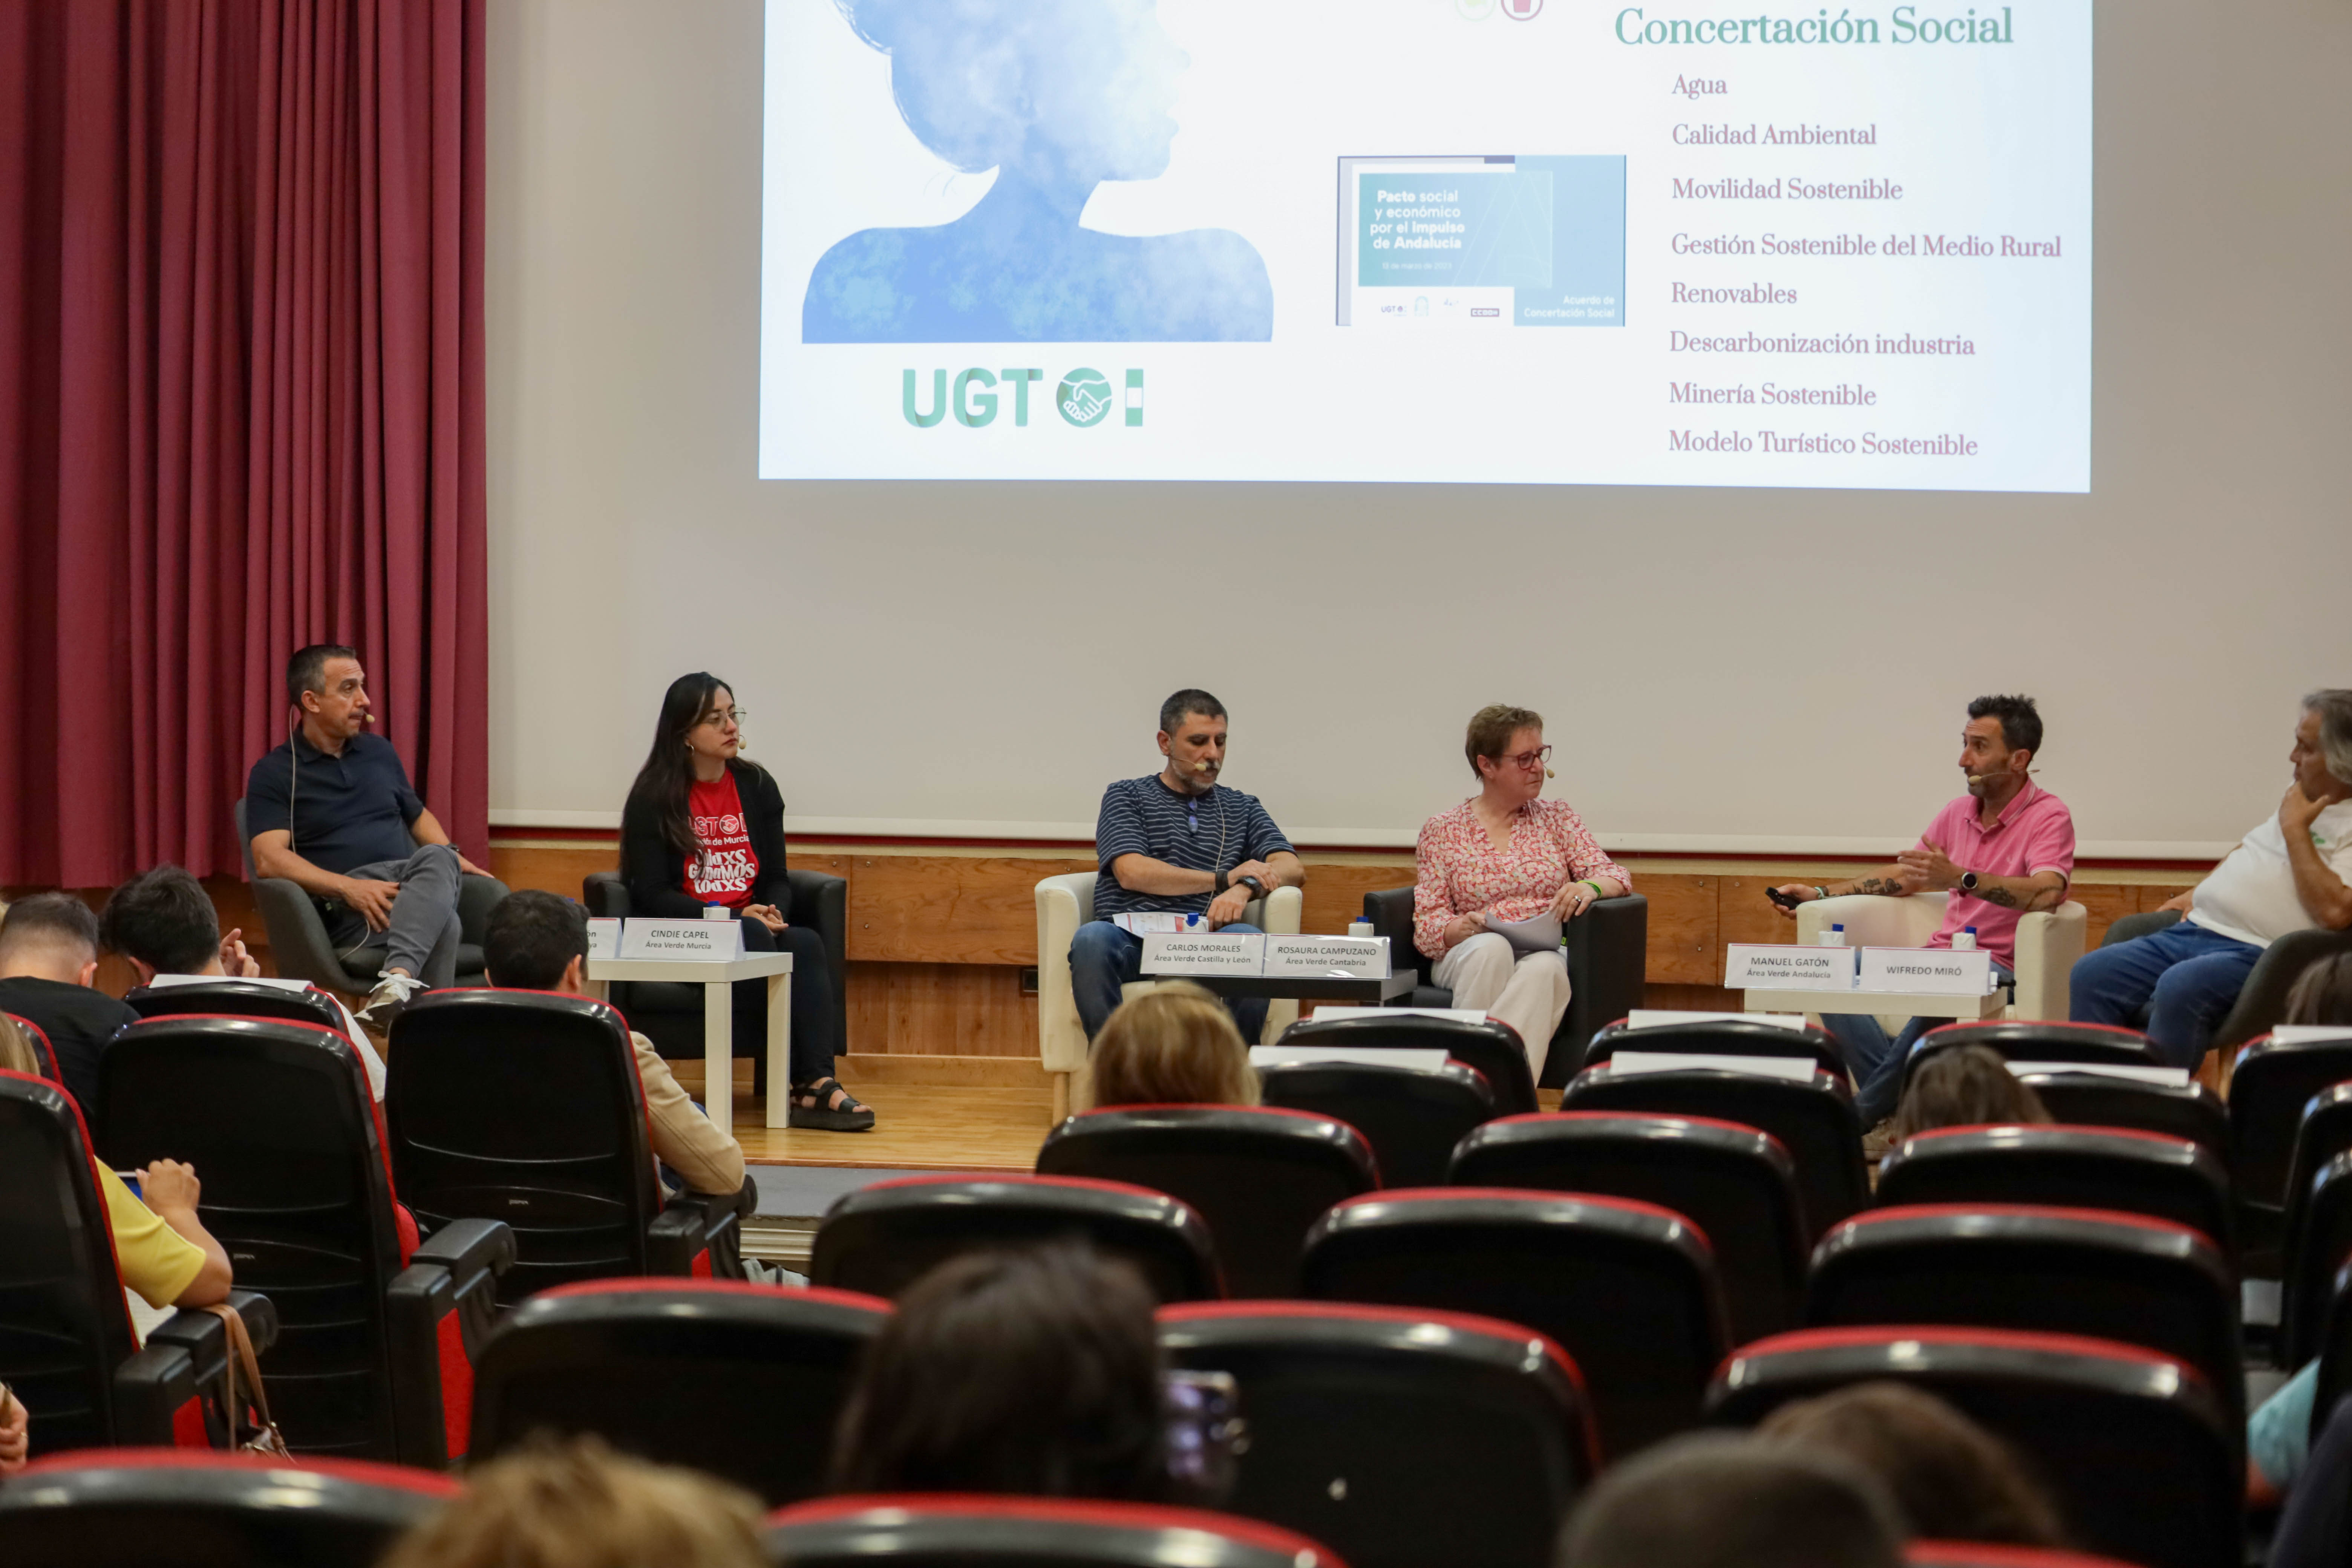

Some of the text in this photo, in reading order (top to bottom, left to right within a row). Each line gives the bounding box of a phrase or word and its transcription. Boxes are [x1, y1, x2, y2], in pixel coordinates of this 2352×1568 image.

[1615, 5, 2014, 45] Concertación Social
[1671, 74, 1728, 100] Agua
[1672, 123, 1877, 145] Calidad Ambiental
[1377, 189, 1458, 203] Pacto social
[1672, 178, 1903, 200] Movilidad Sostenible
[1374, 205, 1461, 221] y económico
[1370, 221, 1465, 236] por el impulso
[1373, 236, 1462, 249] de Andalucía
[1672, 233, 2062, 257] Gestión Sostenible del Medio Rural
[1563, 295, 1615, 305] Acuerdo de
[1671, 282, 1798, 304] Renovables
[1524, 307, 1615, 318] Concertación Social
[1670, 330, 1976, 355] Descarbonización industria
[903, 367, 1043, 428] UGT
[1669, 381, 1876, 406] Minería Sostenible
[1669, 429, 1978, 456] Modelo Turístico Sostenible
[723, 835, 750, 845] Murcia
[651, 930, 709, 939] CINDIE CAPEL
[645, 940, 662, 948] Área
[1321, 947, 1377, 956] CAMPUZANO
[1751, 957, 1829, 967] MANUEL GATÓN
[1747, 969, 1765, 977] Área
[1792, 970, 1831, 979] Andalucía
[1886, 966, 1962, 976] WIFREDO MIRÓ
